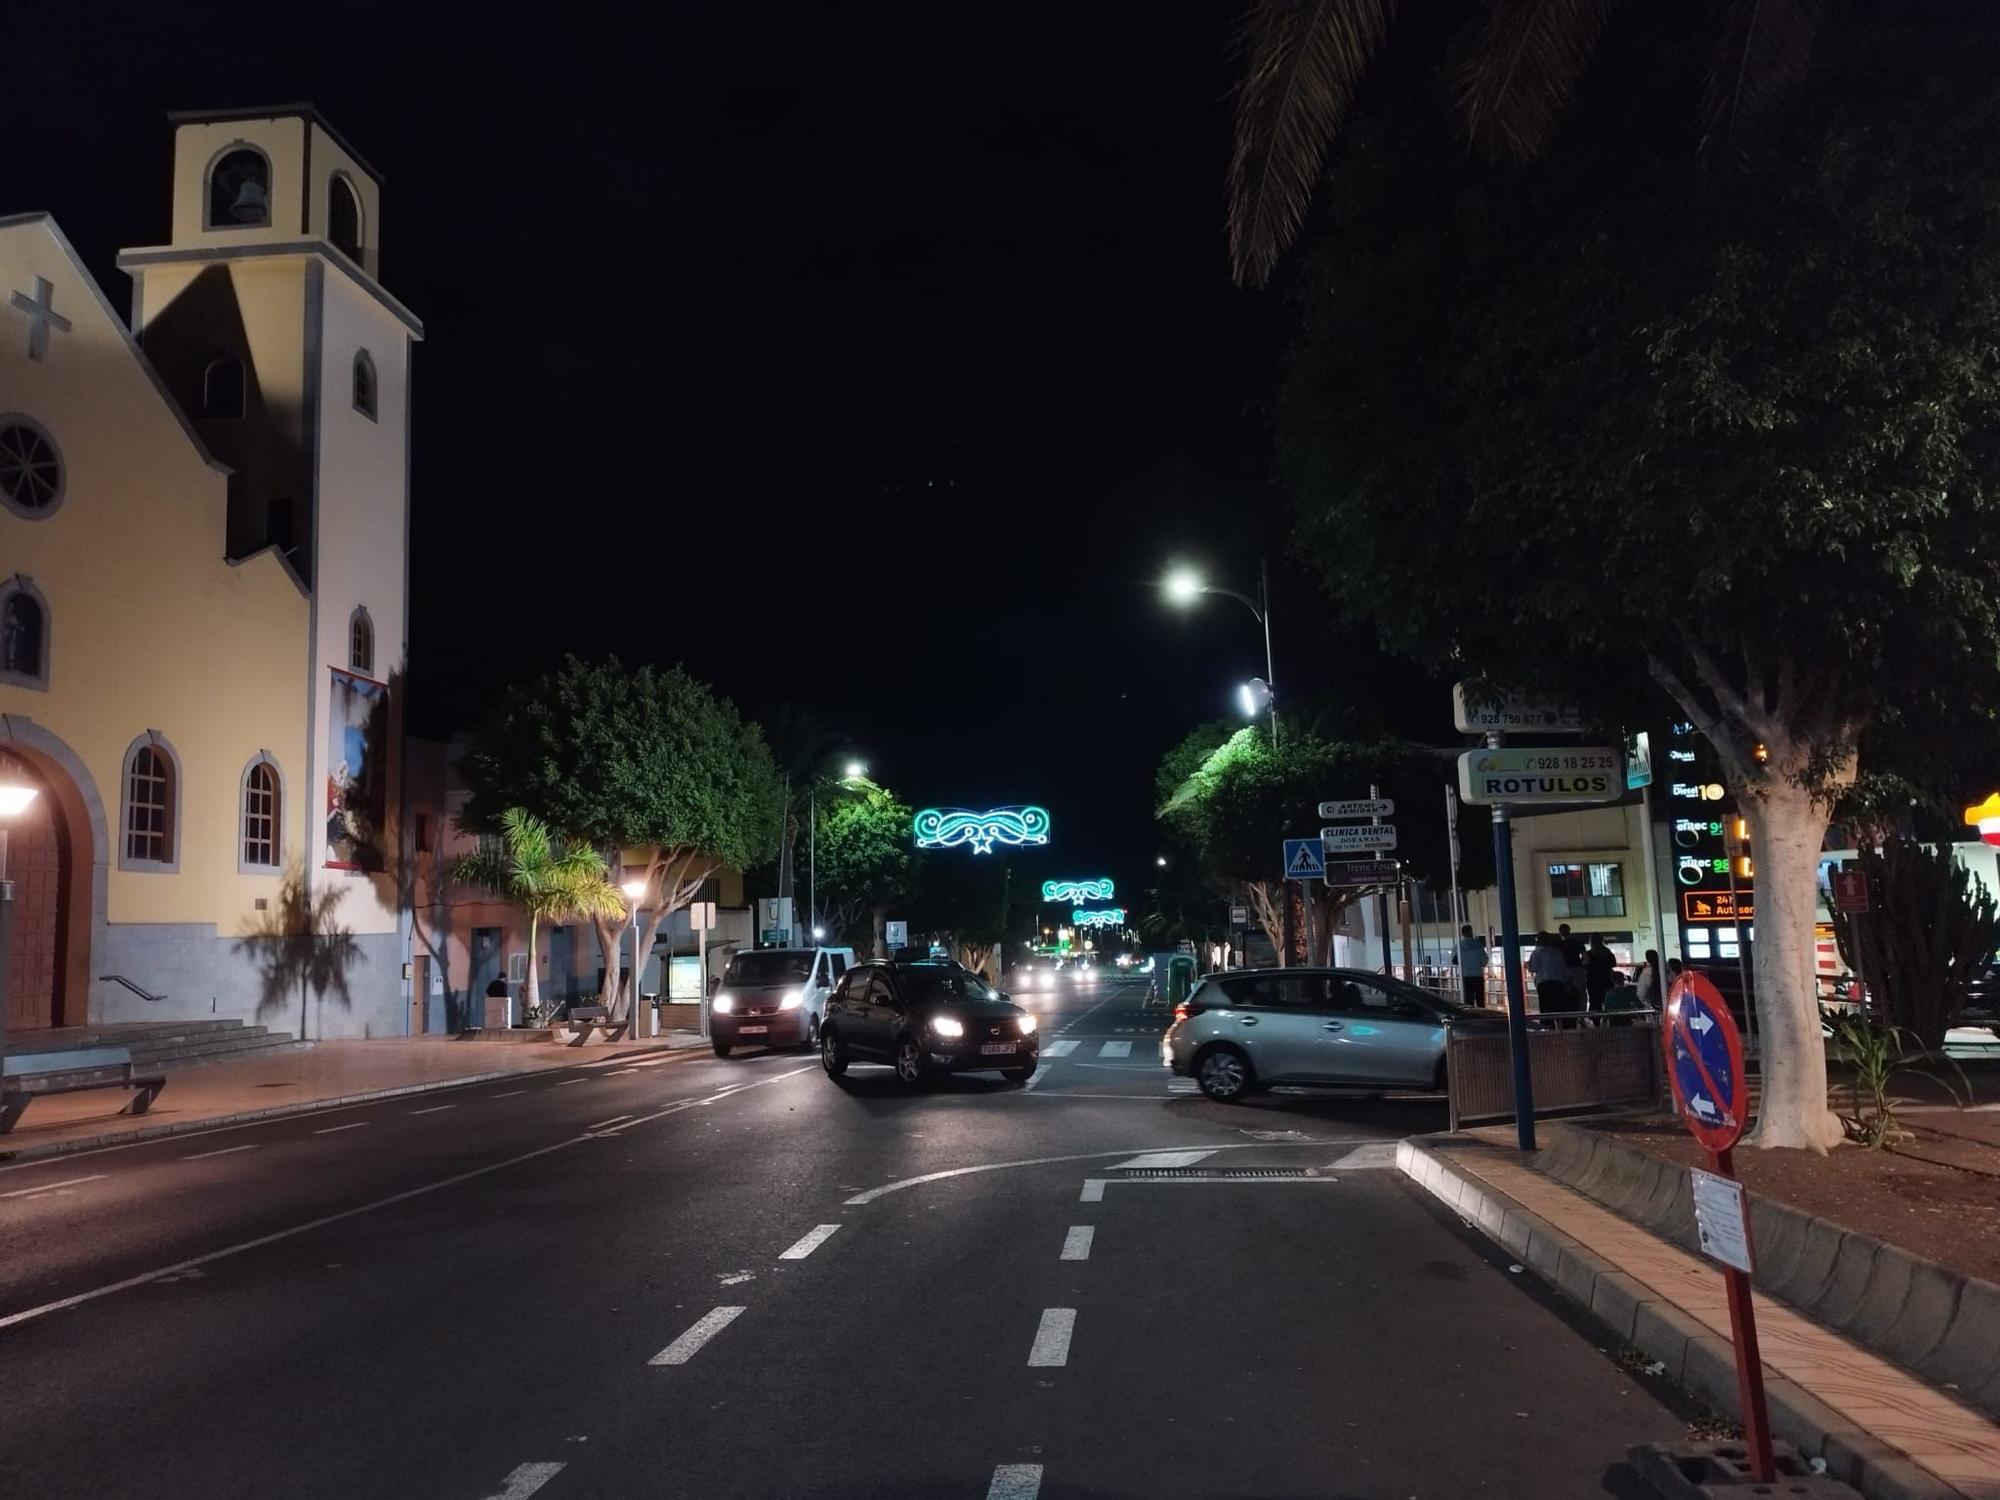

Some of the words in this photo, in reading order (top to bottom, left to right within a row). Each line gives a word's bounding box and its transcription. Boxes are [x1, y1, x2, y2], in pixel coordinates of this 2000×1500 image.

[1538, 757, 1559, 769] 928
[1563, 757, 1577, 769] 18
[1581, 757, 1595, 768] 25
[1599, 757, 1613, 768] 25
[1486, 777, 1606, 793] ROTULOS
[1325, 828, 1359, 837] CLINICA
[1361, 827, 1394, 836] DENTAL
